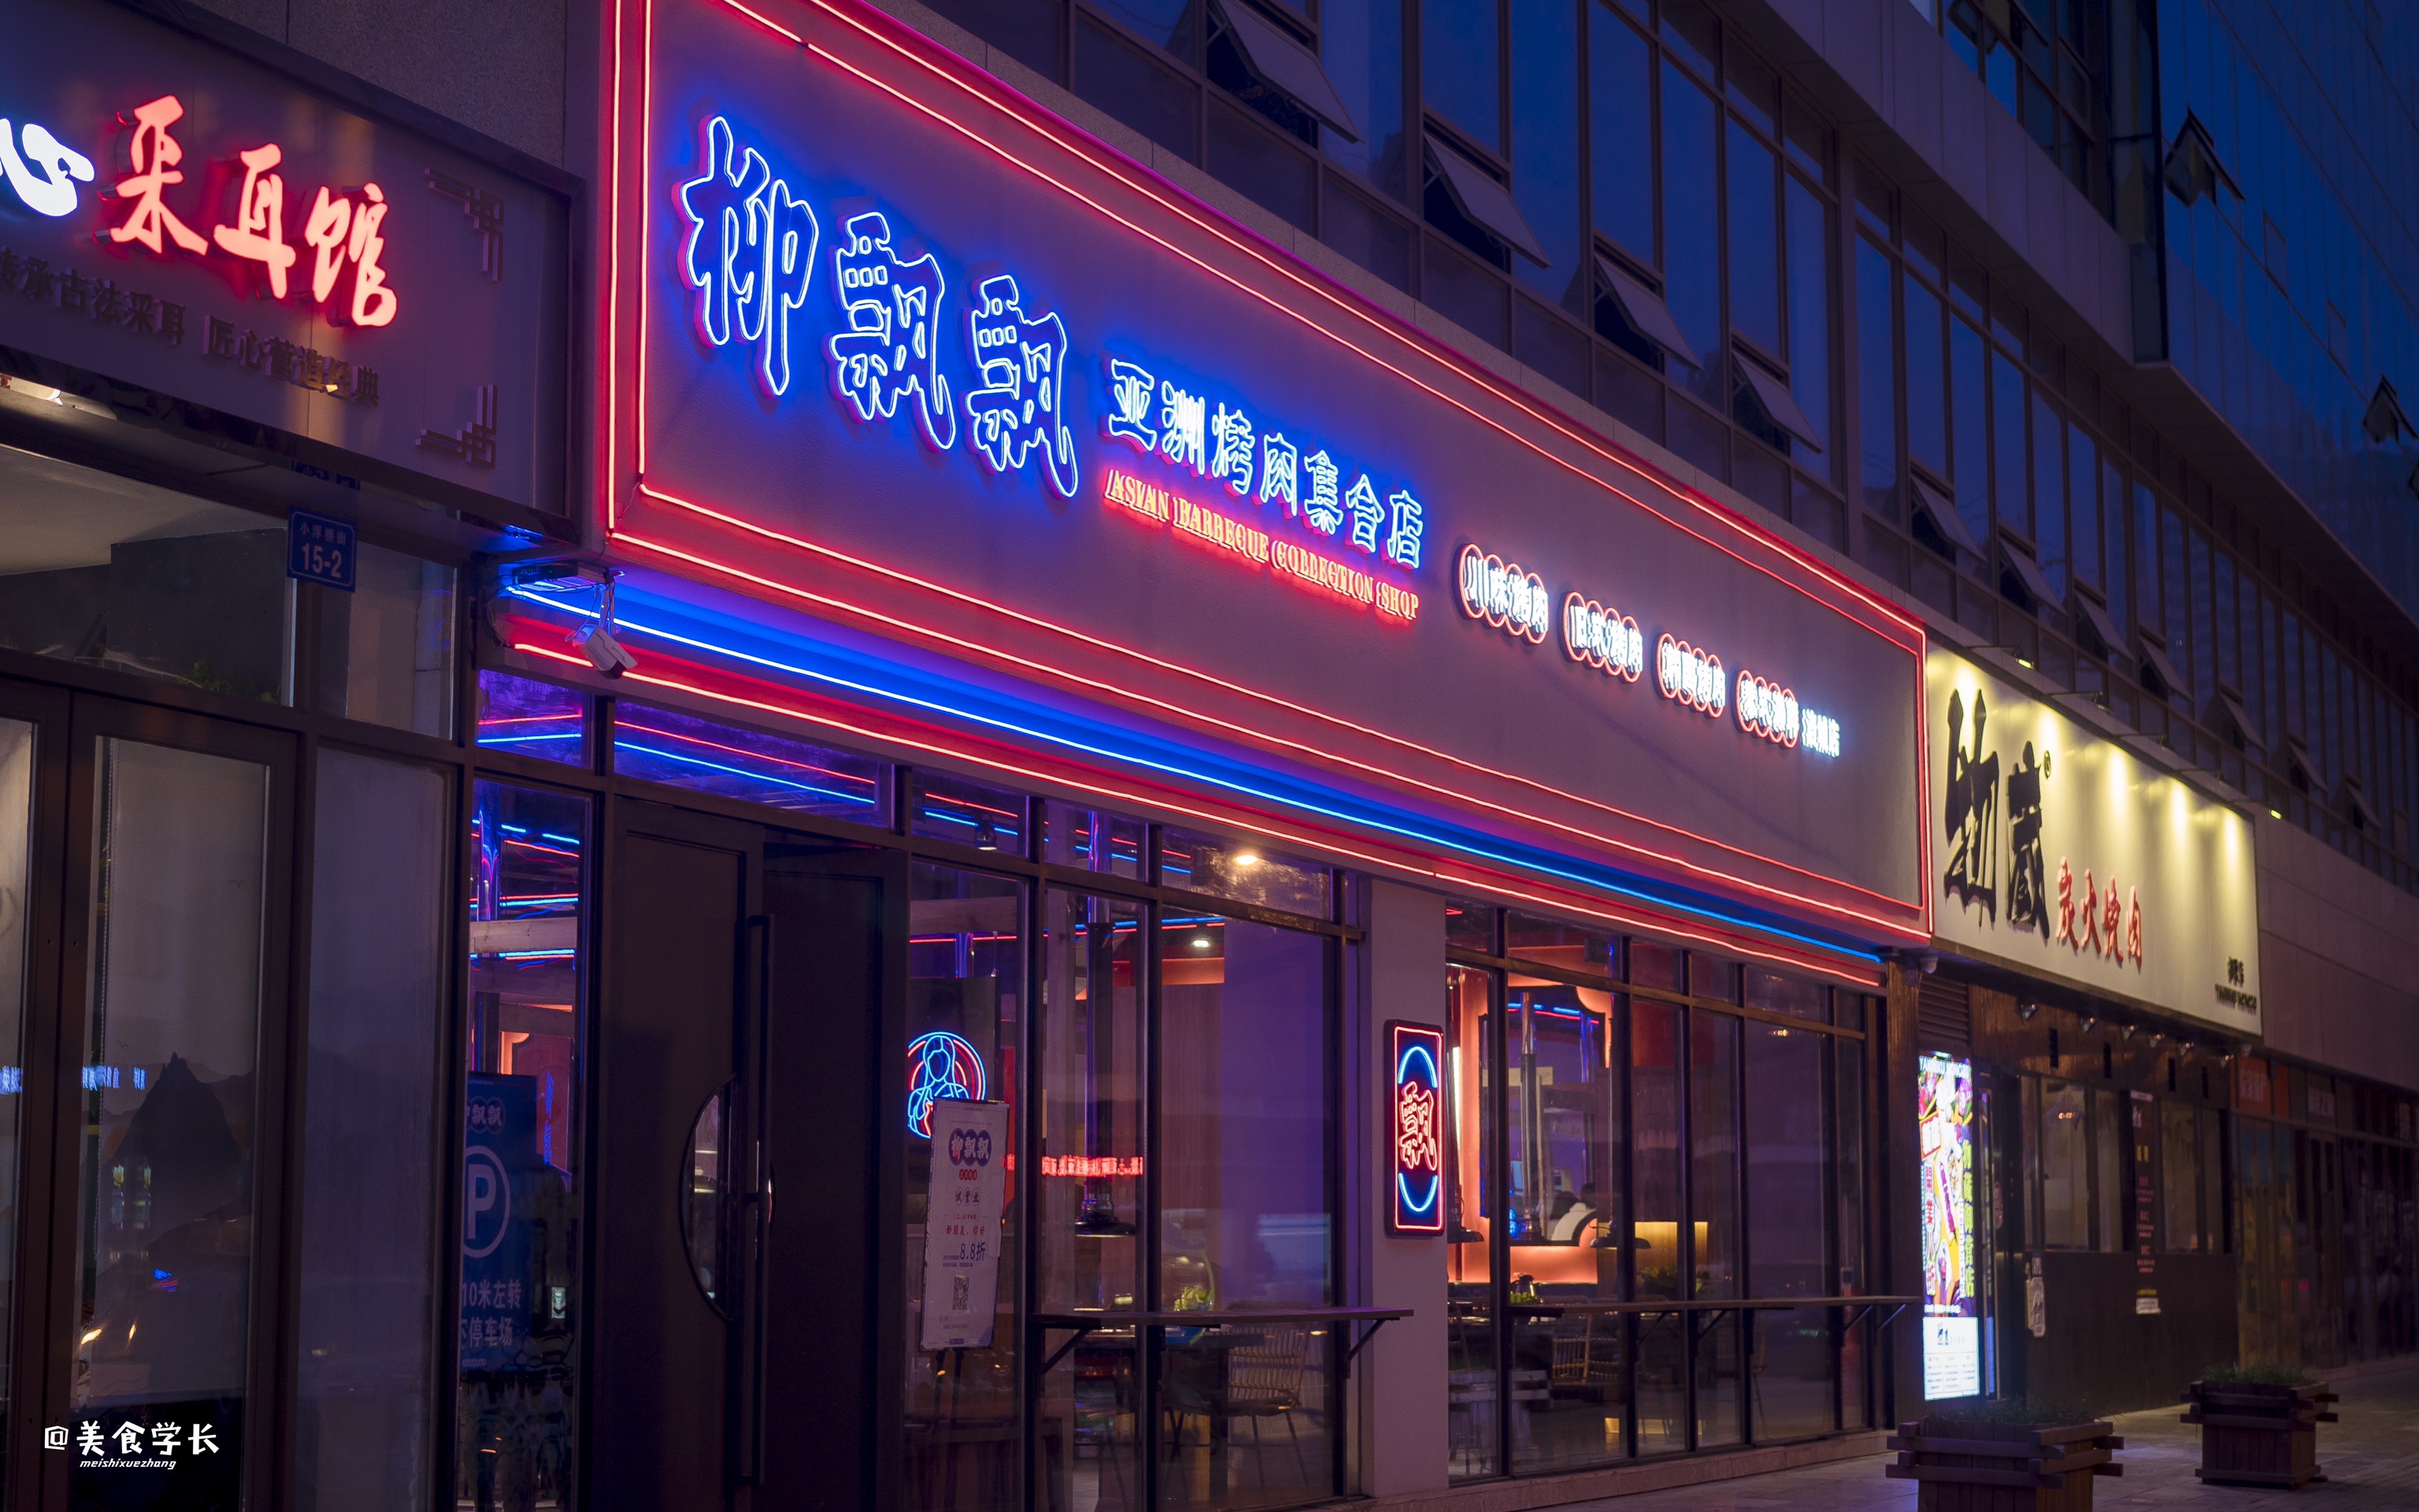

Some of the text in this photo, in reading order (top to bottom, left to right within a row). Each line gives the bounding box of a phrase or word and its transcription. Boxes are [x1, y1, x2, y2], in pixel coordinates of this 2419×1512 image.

[679, 116, 1078, 498] 柳飘飘
[1108, 358, 1423, 569] 亚洲烤肉集合店
[302, 543, 343, 578] 15-2
[1109, 470, 1419, 620] ASIAN BARBEQUE COLLECTION SHOP
[955, 1188, 980, 1203] 试营业
[960, 1241, 986, 1262] 8.8折
